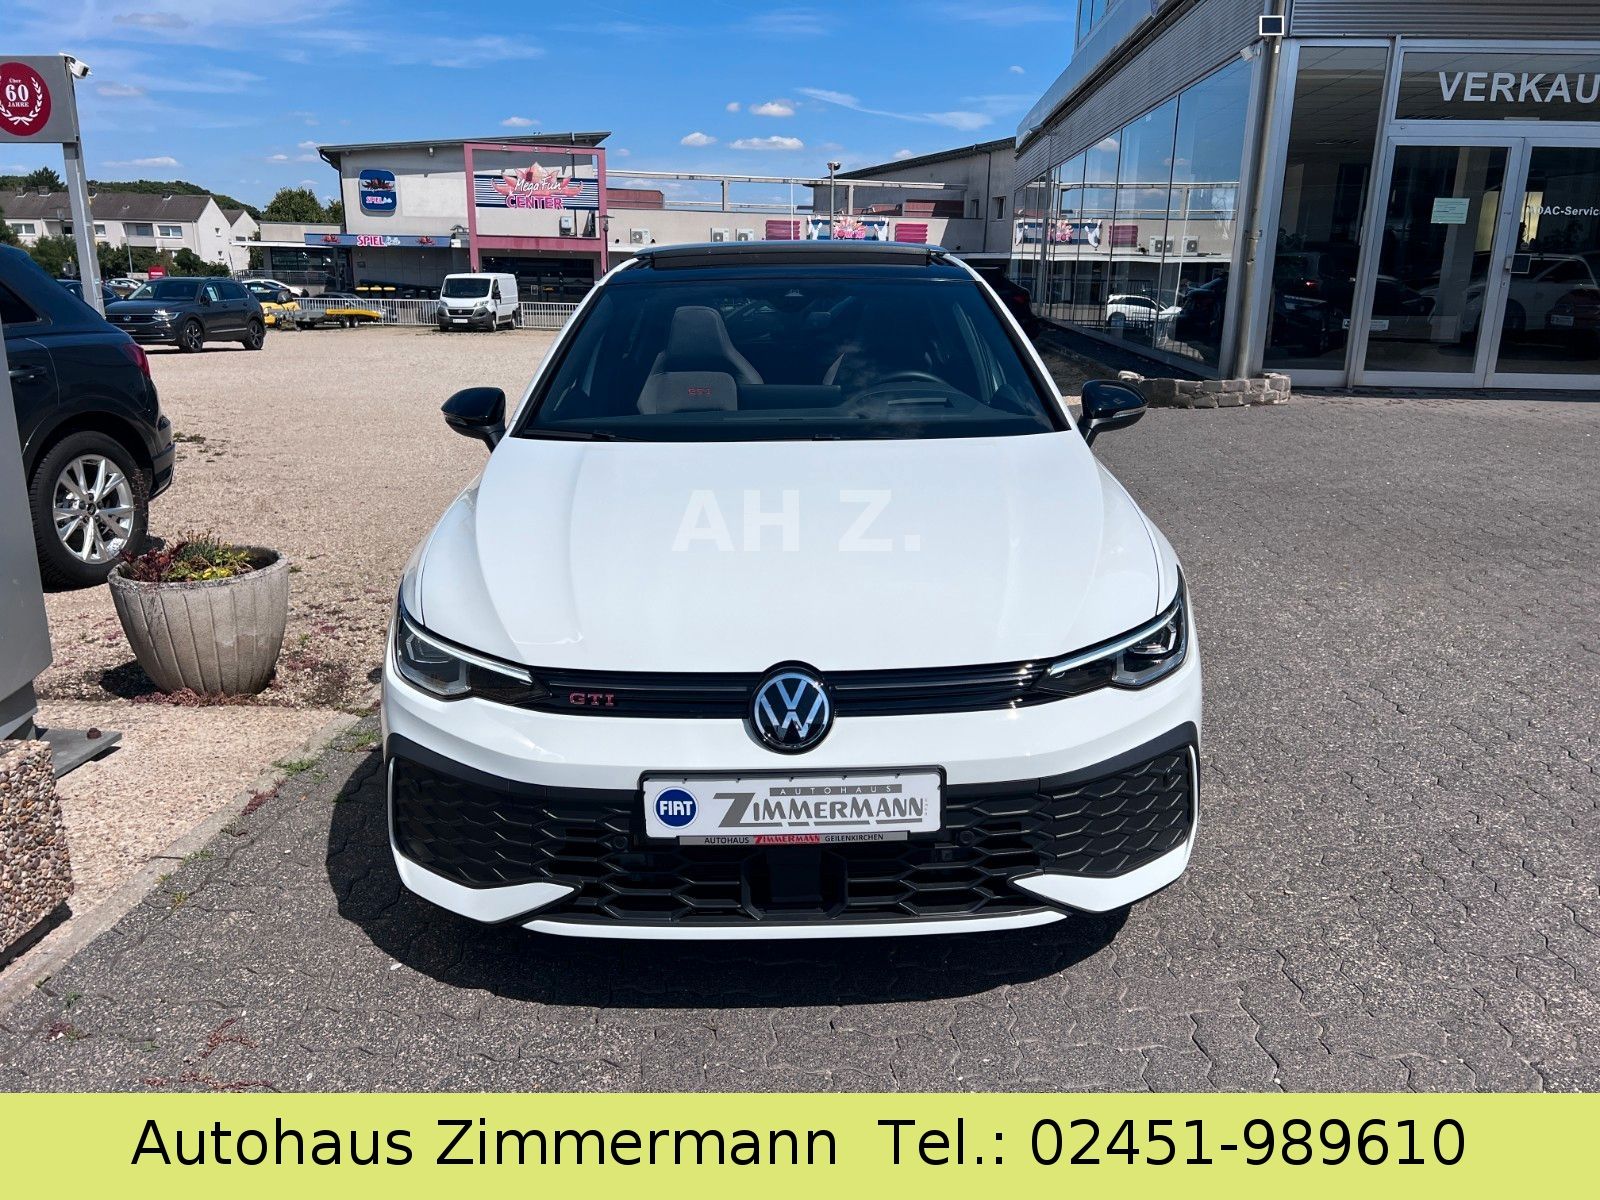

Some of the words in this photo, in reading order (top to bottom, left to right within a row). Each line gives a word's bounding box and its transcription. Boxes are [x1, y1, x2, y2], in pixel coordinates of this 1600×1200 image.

[5, 84, 29, 101] 60
[1438, 71, 1600, 104] VERKAU
[514, 179, 539, 197] Mega
[540, 176, 562, 191] Fun
[505, 194, 563, 209] CENTER
[1529, 205, 1600, 216] ADAC-Servic
[356, 234, 385, 247] SPIEL
[569, 692, 615, 706] GTI
[779, 786, 893, 797] AUTOHAUS
[659, 799, 694, 815] FIAT
[711, 791, 924, 828] ZIMMERMANN
[704, 836, 750, 844] AUTOHAUS
[753, 834, 821, 844] ZIMMERMANN
[824, 833, 884, 843] GEILENKIRCHEN
